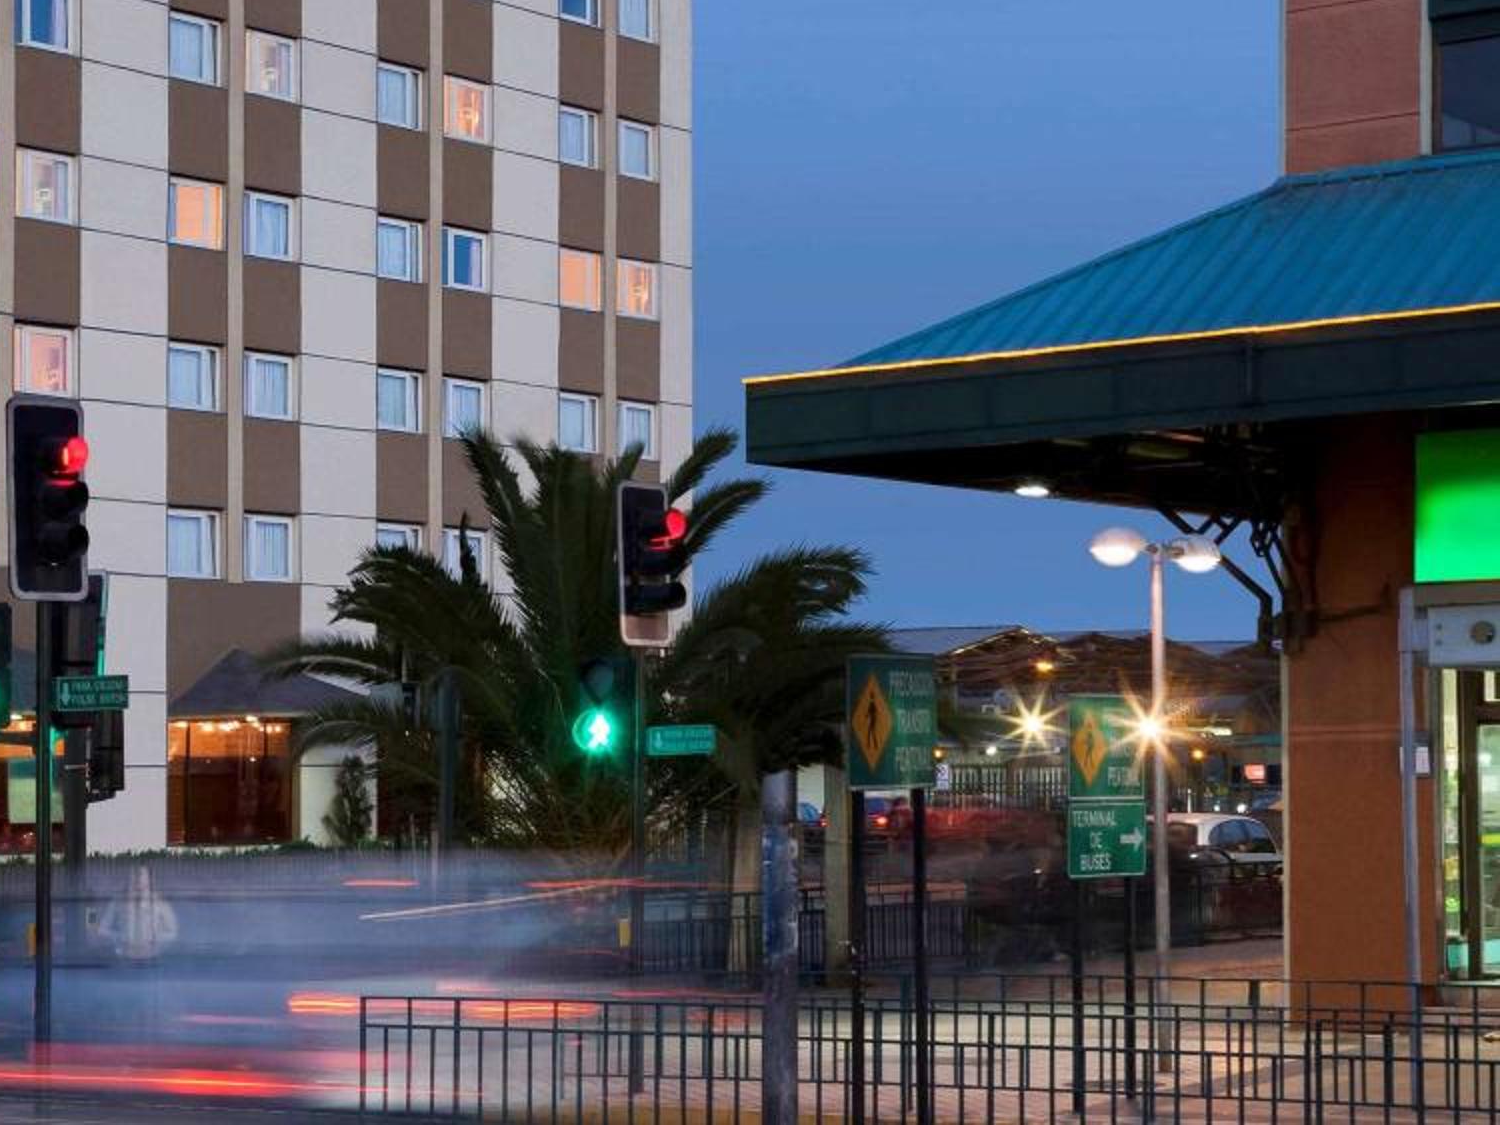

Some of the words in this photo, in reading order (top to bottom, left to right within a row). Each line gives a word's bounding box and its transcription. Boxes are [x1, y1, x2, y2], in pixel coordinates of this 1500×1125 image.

[1072, 810, 1117, 828] TERMINAL
[1090, 831, 1103, 849] DE
[1080, 854, 1112, 871] BUSES
